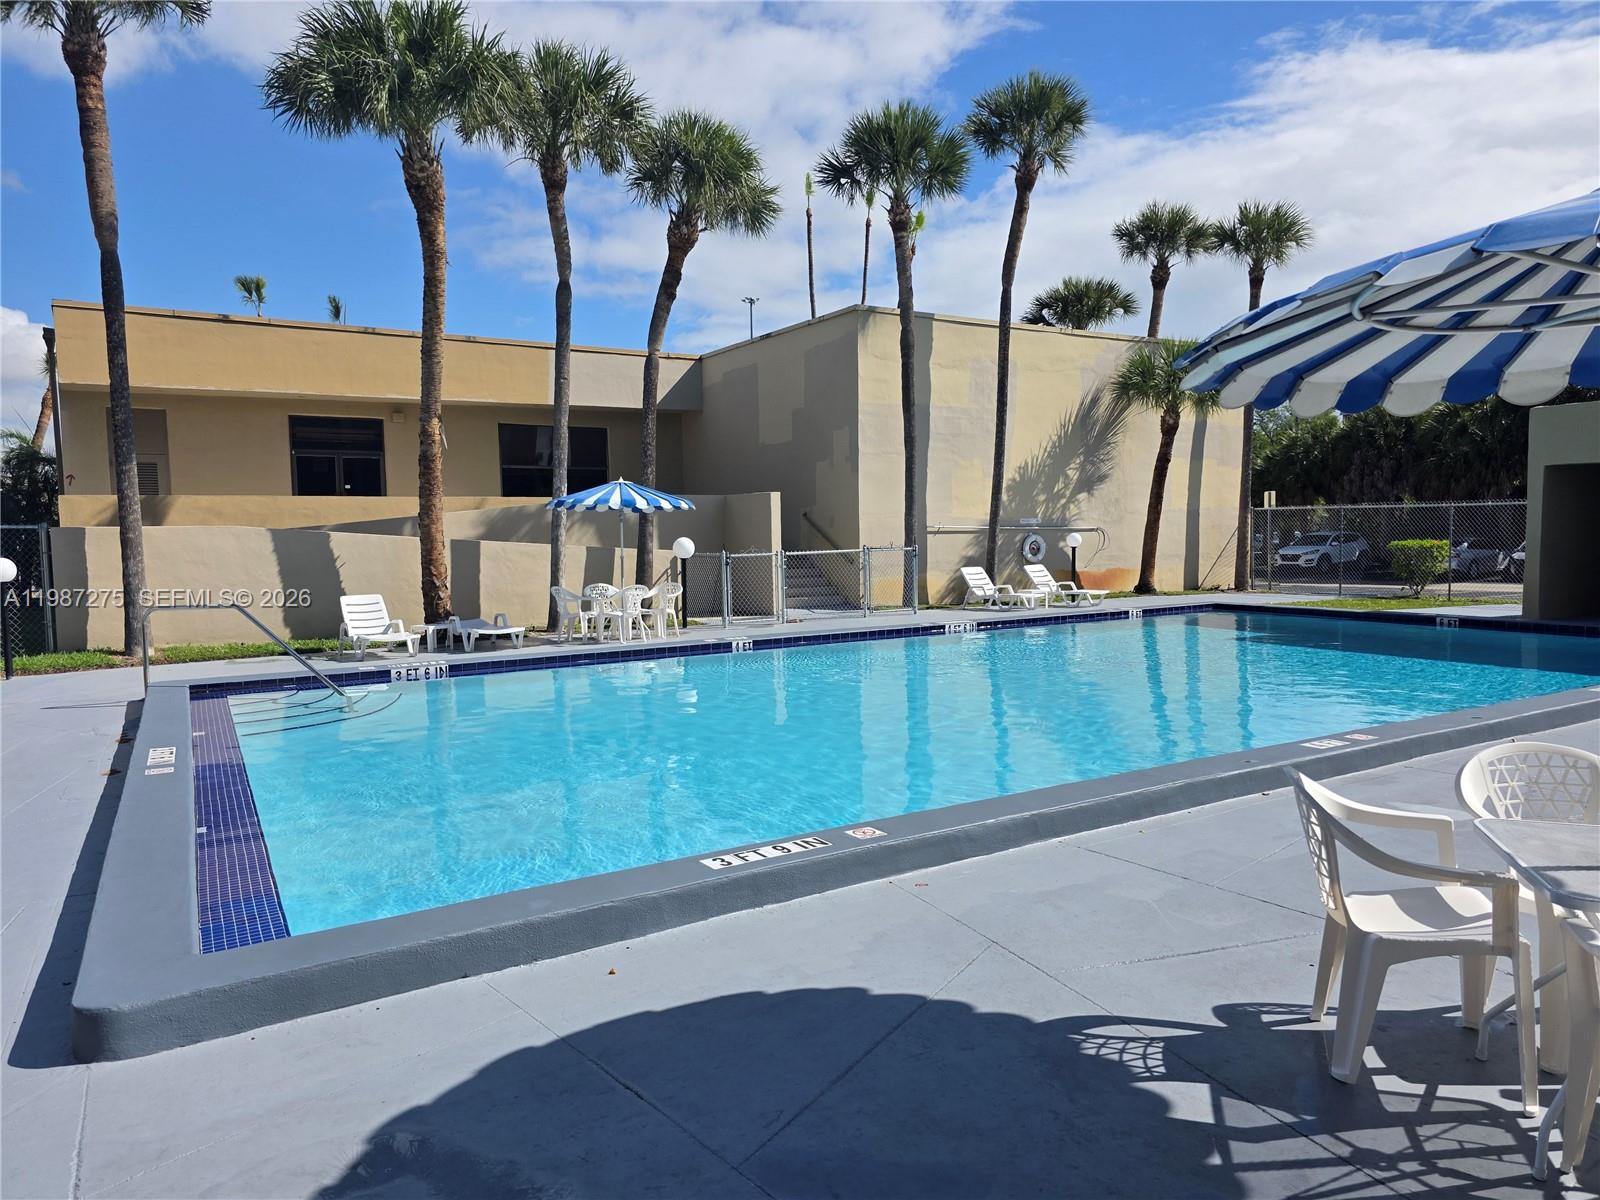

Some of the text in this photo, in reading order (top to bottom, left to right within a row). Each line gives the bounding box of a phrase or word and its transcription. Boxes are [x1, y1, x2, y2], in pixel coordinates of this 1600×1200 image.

[395, 670, 402, 681] 3
[712, 837, 829, 867] 3 FT 9 IN
